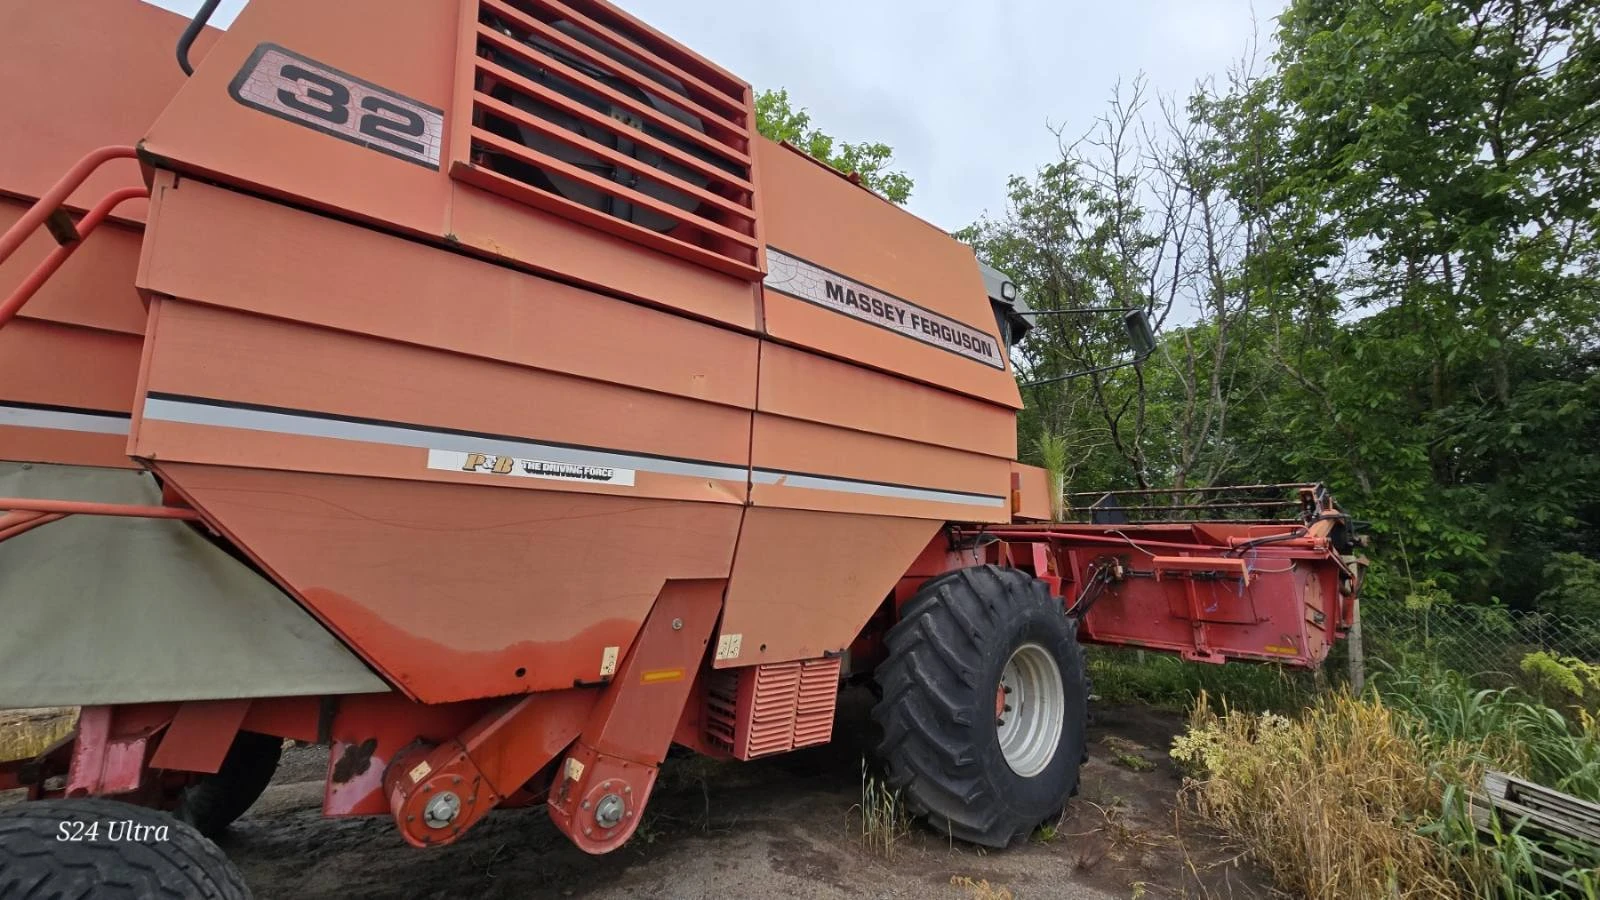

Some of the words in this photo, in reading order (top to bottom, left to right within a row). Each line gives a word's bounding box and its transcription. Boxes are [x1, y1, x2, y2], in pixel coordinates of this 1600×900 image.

[277, 64, 425, 155] 32
[825, 280, 906, 325] MASSEY
[911, 313, 993, 358] FERGUSON
[462, 452, 515, 475] P&B
[520, 459, 542, 474] THE
[542, 461, 583, 478] DRIVING
[584, 465, 614, 481] FORCE
